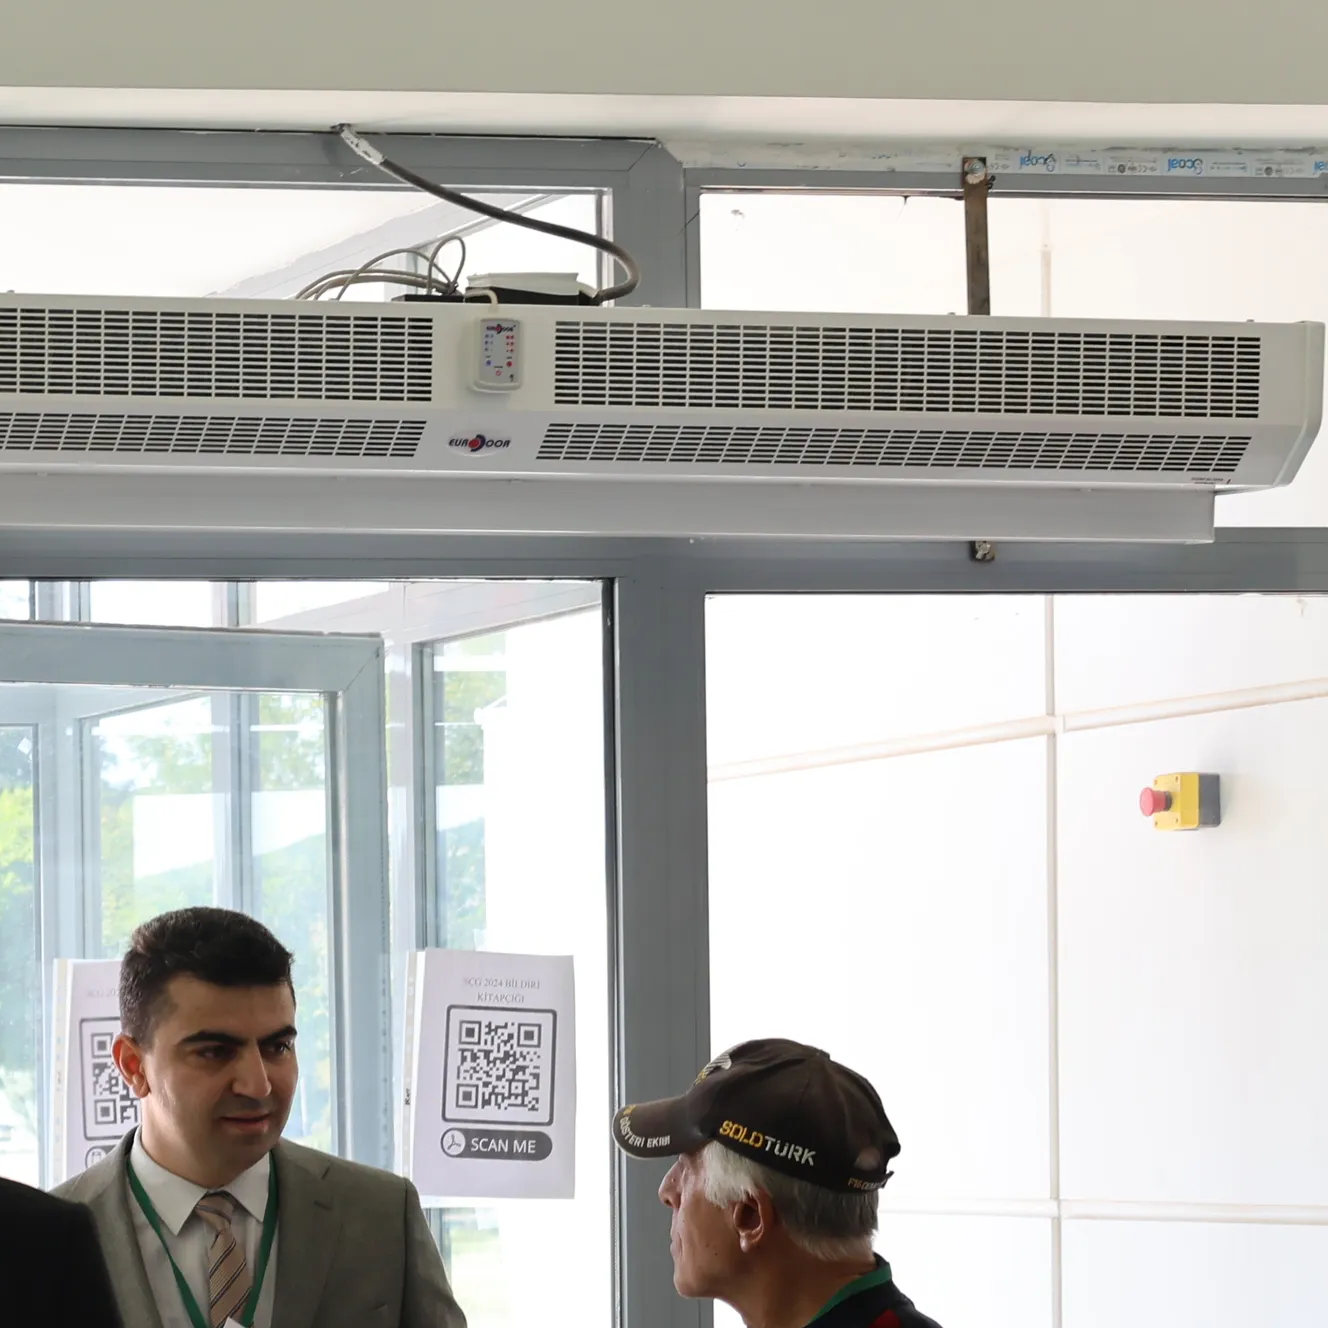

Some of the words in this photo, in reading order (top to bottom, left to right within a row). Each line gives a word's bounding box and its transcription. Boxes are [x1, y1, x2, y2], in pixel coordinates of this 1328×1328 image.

[448, 433, 511, 452] EURODOOR
[470, 1138, 508, 1153] SCAN
[513, 1140, 536, 1154] ME
